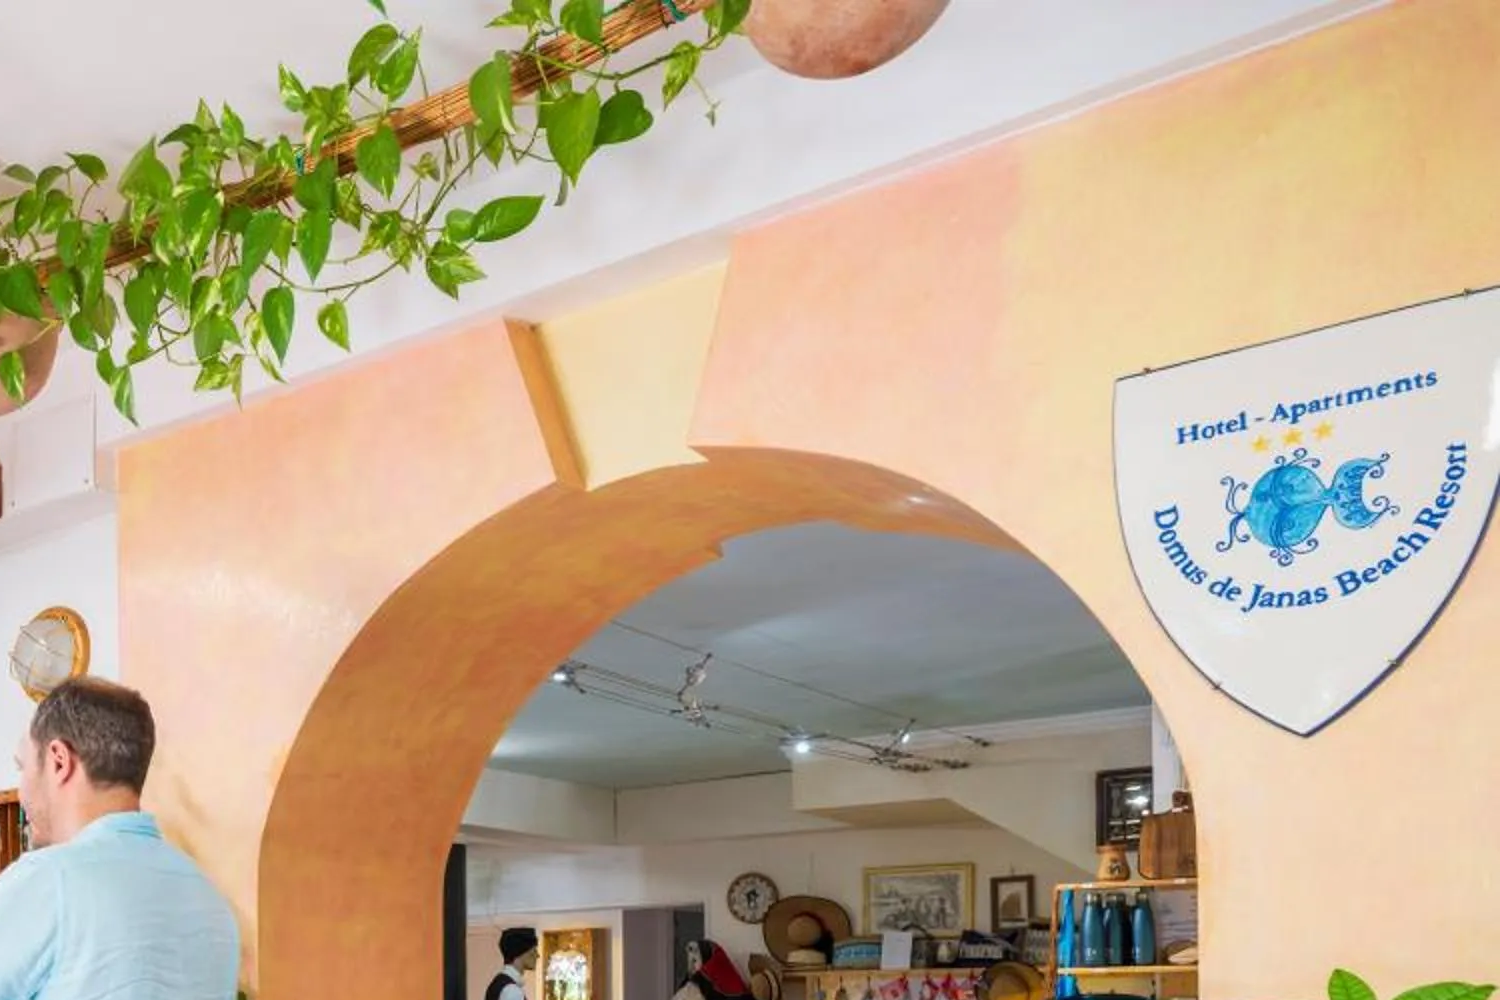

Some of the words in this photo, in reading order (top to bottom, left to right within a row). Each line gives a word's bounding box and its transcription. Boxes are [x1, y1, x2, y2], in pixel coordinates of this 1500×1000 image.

[1177, 412, 1247, 445] Hotel
[1271, 370, 1438, 425] Apartments
[1154, 505, 1207, 585] Domus
[1209, 576, 1242, 601] de
[1241, 584, 1329, 613] Janas
[1334, 532, 1430, 597] Beach
[1412, 441, 1467, 531] Resort
